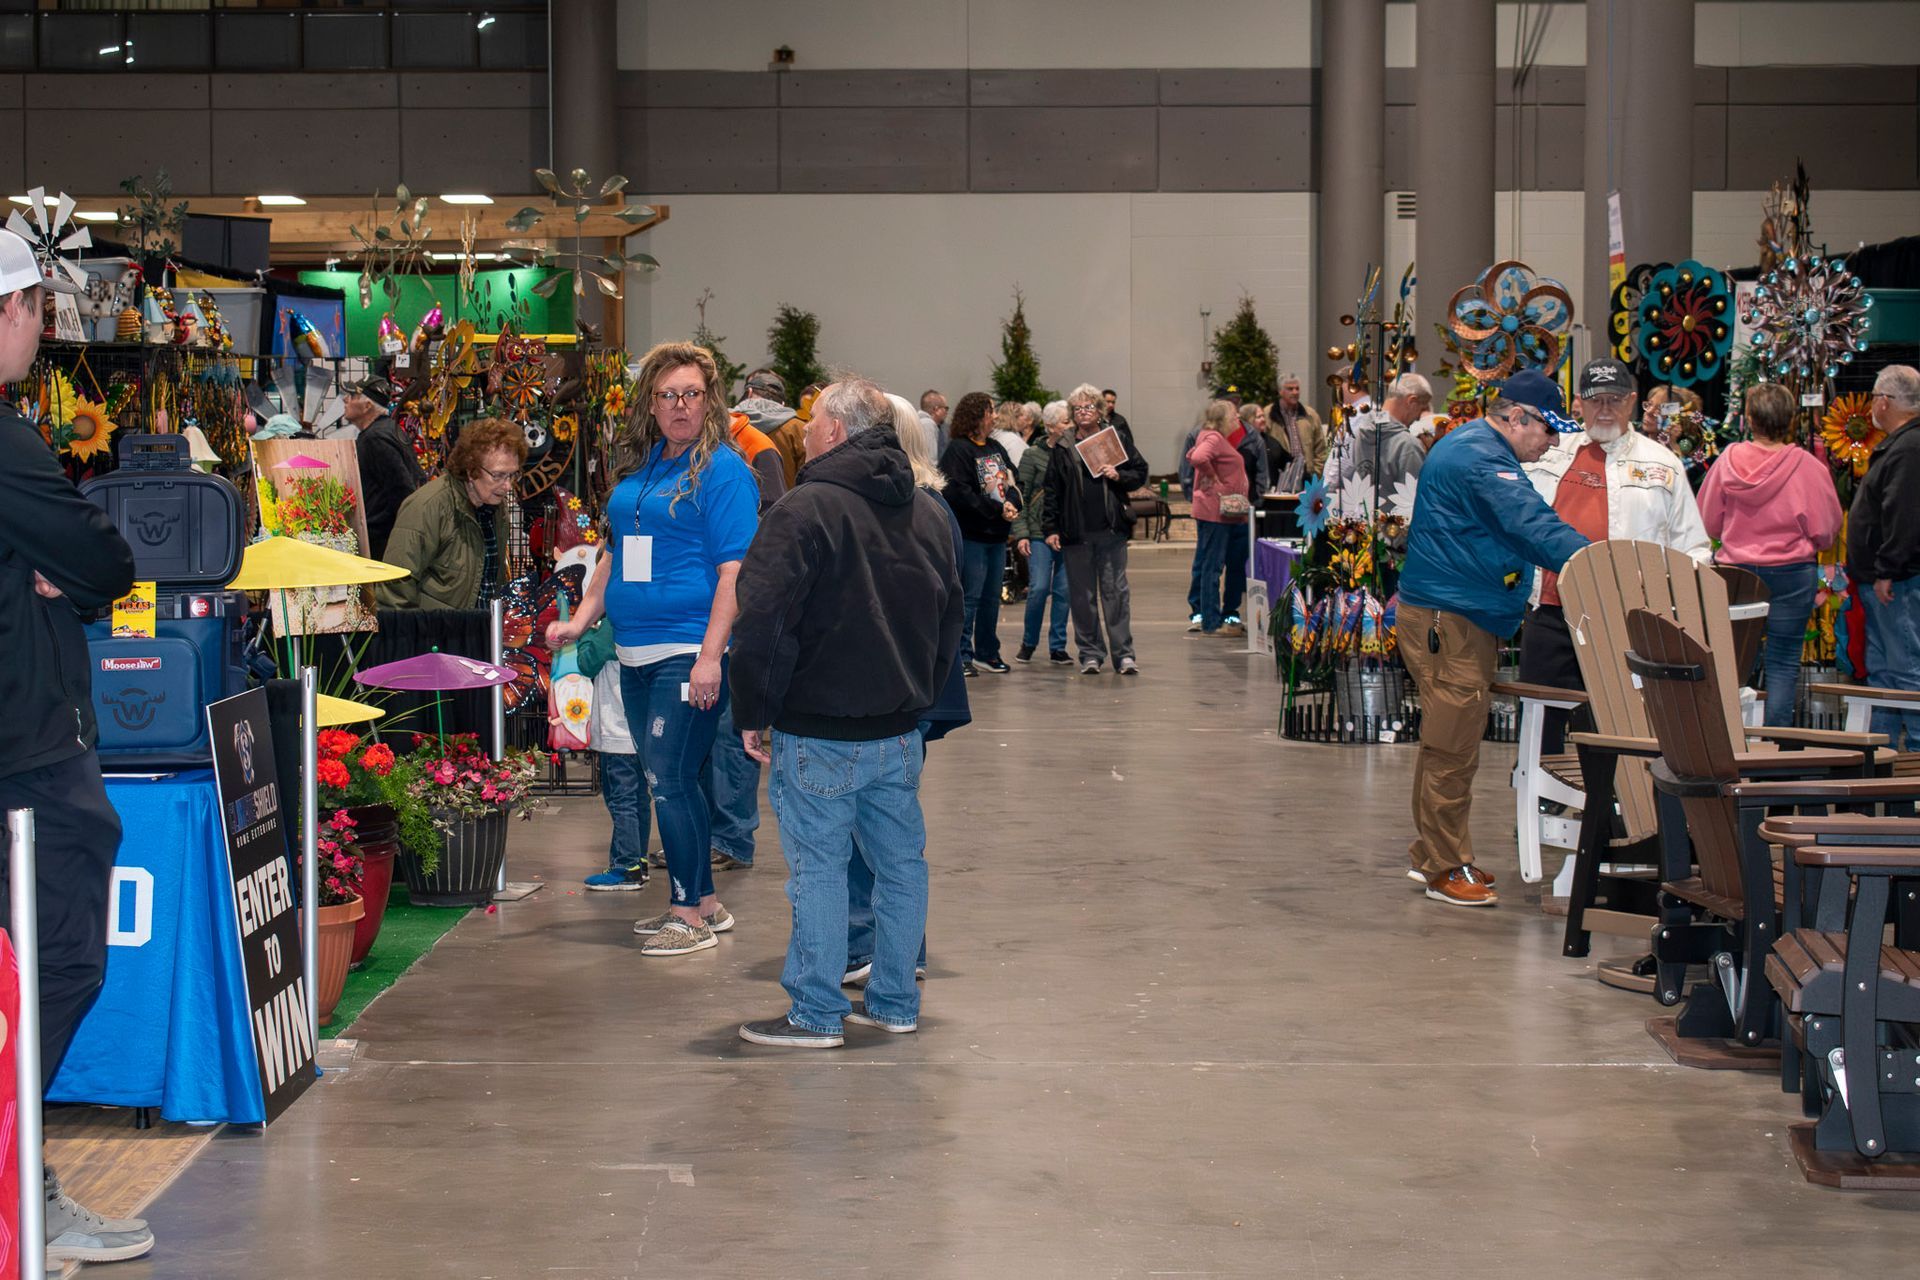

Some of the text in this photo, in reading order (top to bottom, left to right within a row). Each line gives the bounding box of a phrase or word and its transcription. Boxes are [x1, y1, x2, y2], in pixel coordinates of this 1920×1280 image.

[251, 818, 277, 840] EXTERIORS
[236, 855, 293, 938] ENTER
[264, 933, 282, 979] TO
[254, 976, 312, 1095] WIN
